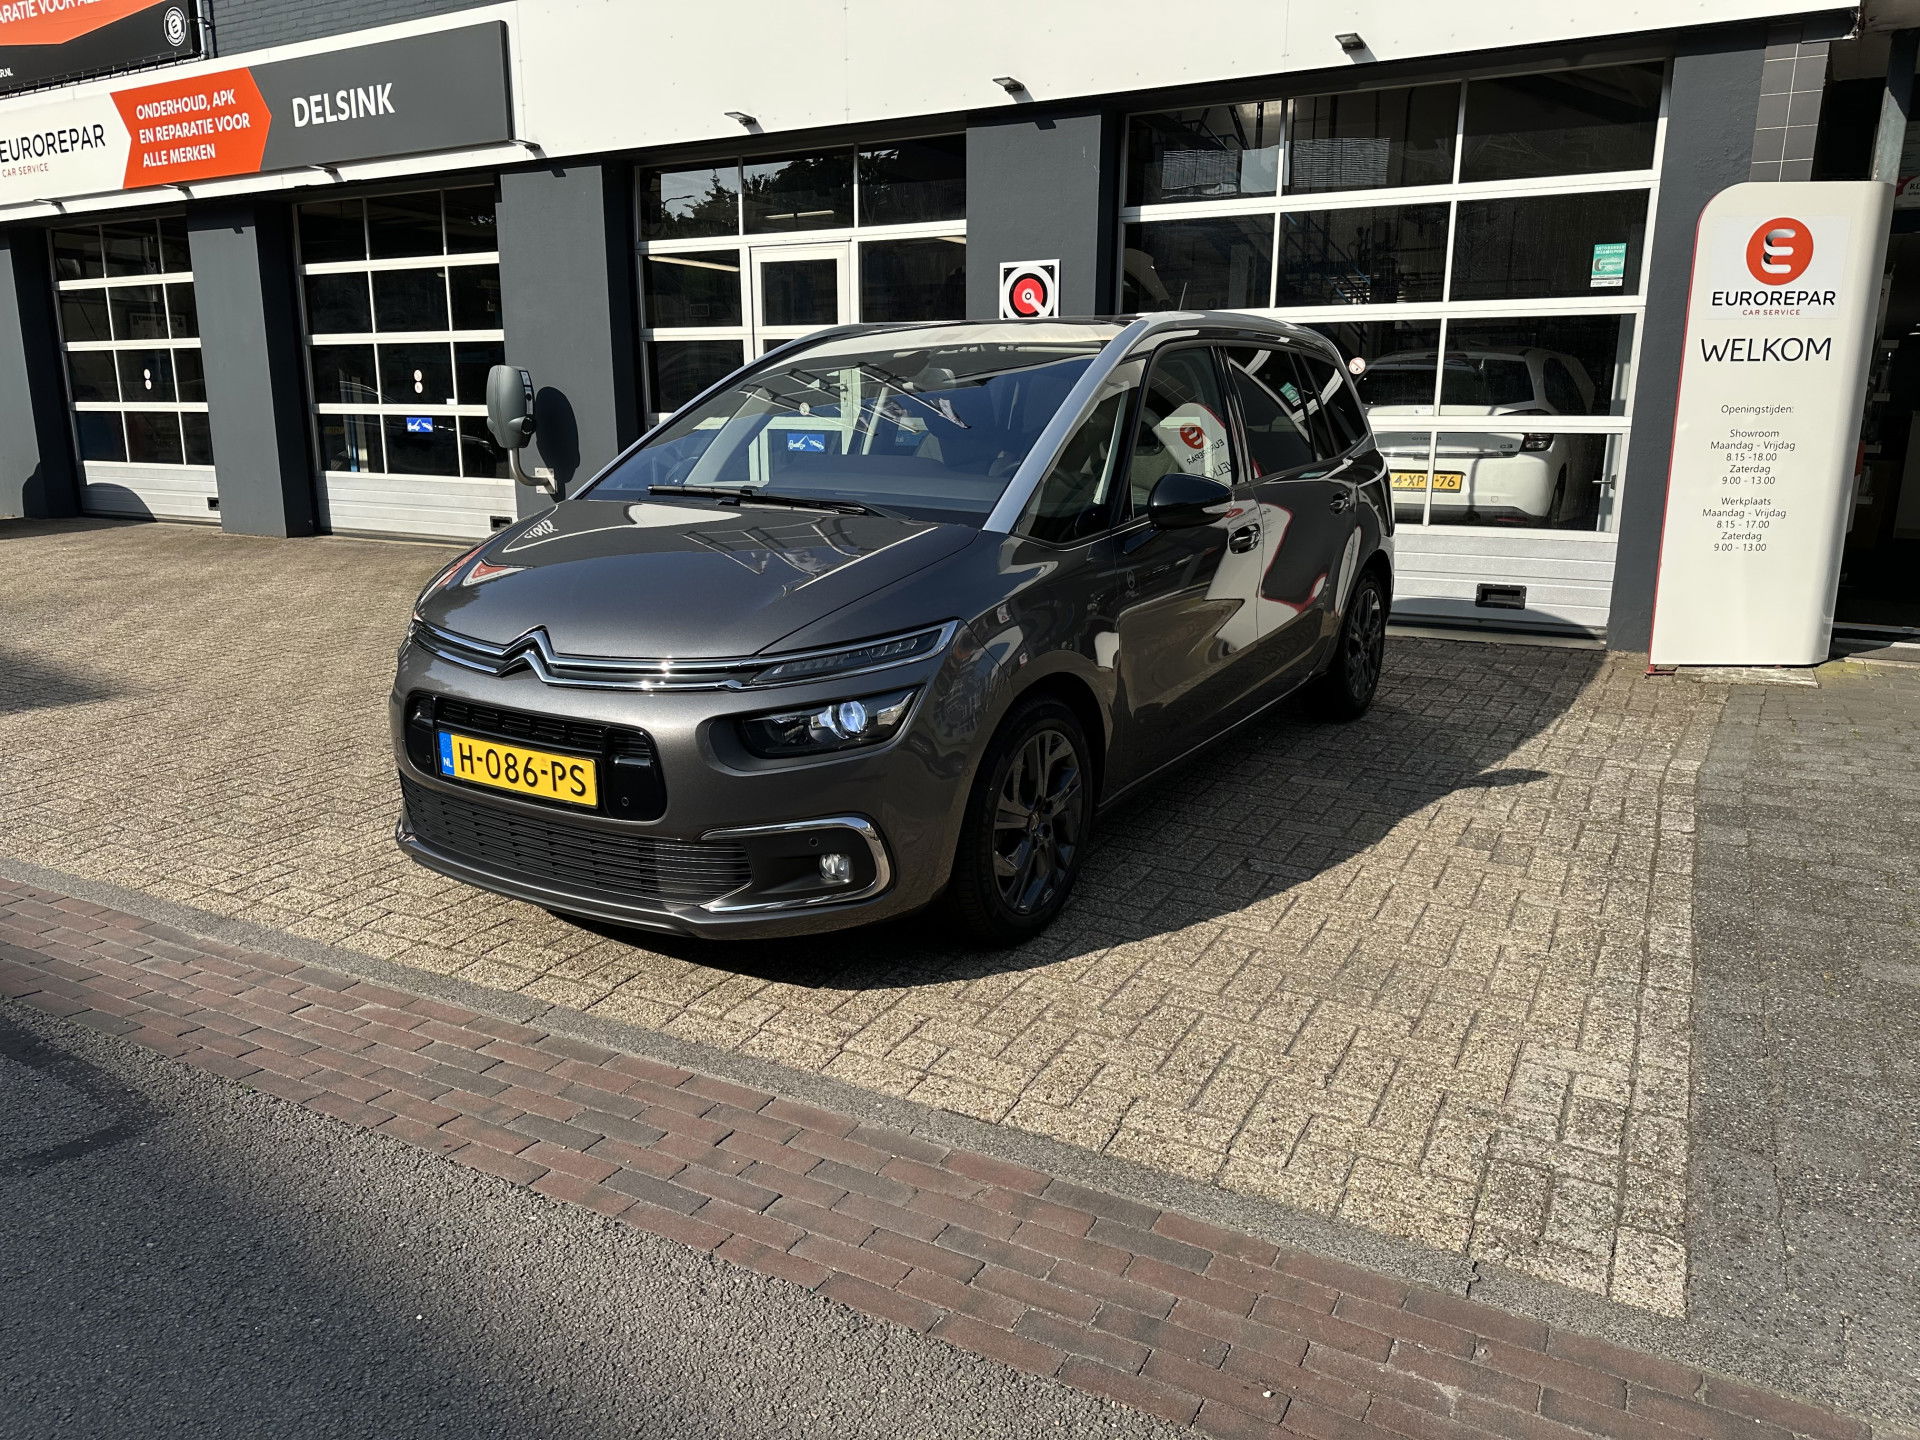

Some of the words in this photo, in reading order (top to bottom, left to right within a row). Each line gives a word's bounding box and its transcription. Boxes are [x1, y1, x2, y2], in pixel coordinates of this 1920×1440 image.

[136, 95, 211, 120] ONDERHOUD,
[212, 89, 236, 108] APK
[292, 82, 395, 128] DELSINK
[139, 128, 154, 144] EN
[155, 119, 215, 142] REPARATIE
[215, 112, 251, 133] VOOR
[0, 124, 106, 163] EUROREPAR
[143, 151, 169, 168] ALLE
[170, 144, 216, 165] MERKEN
[2, 168, 17, 178] CAR
[19, 163, 49, 176] SERVICE
[1712, 290, 1836, 306] EUROREPAR
[1701, 337, 1832, 362] WELKOM
[1720, 404, 1794, 415] Openingstijden:
[1729, 429, 1780, 438] Showroom
[1710, 441, 1754, 451] Maandag
[1763, 441, 1796, 451] Vrijdag
[1726, 453, 1745, 462] 8.15
[1729, 464, 1771, 475] Zaterdag
[1394, 475, 1456, 488] 4-XP-76
[1750, 476, 1776, 485] 13.00
[1721, 497, 1771, 507] Werkplaats
[1702, 509, 1745, 519] Maandag
[1755, 509, 1787, 519] Vrijdag
[1746, 520, 1770, 529] 17.00
[1721, 532, 1762, 542] Zaterdag
[443, 757, 453, 768] NL
[458, 742, 586, 797] H-086-PS
